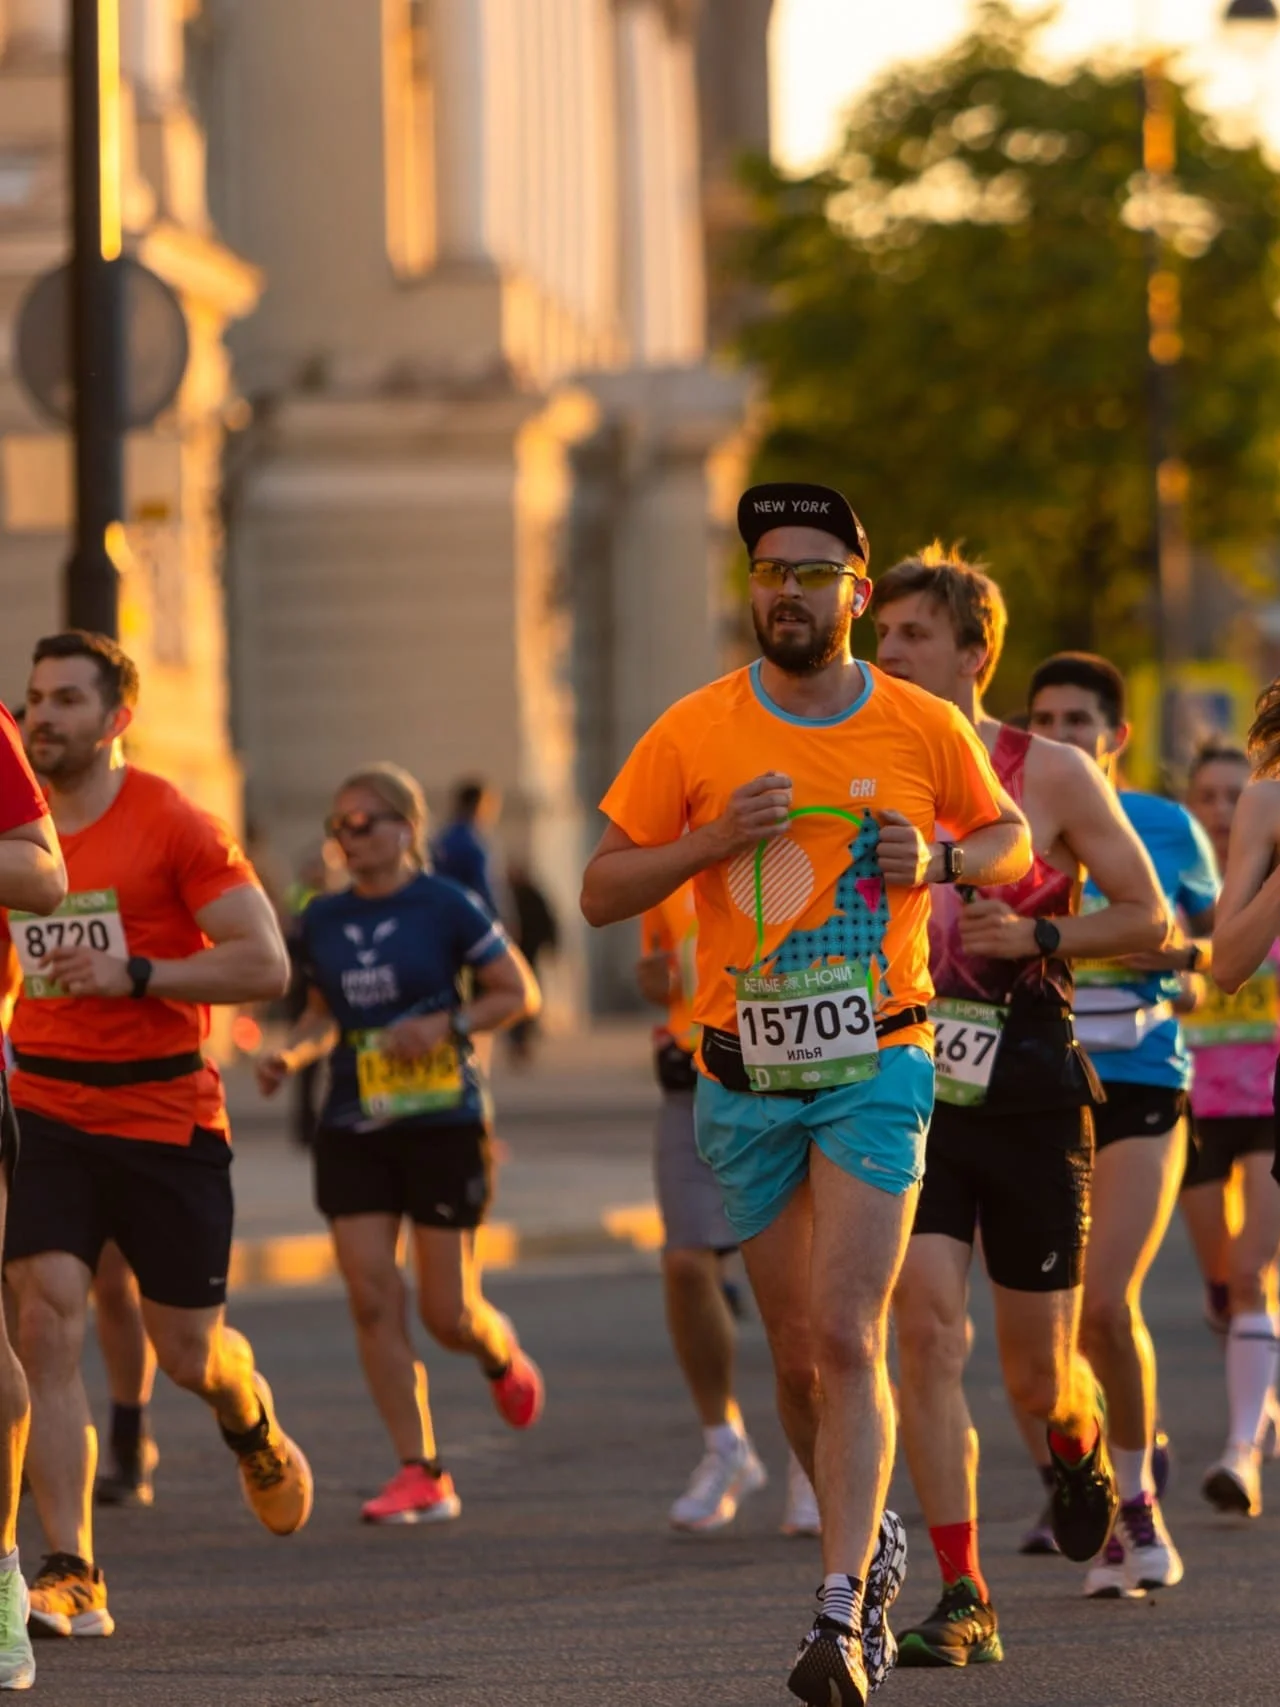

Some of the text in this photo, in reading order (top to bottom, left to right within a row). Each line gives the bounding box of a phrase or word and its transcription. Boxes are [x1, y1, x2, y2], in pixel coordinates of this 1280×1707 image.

[753, 500, 831, 514] NEW YORK
[26, 919, 109, 958] 8720
[744, 976, 781, 993] БЕЛЫЕ
[804, 965, 853, 988] НОЧИ
[742, 995, 870, 1046] 15703
[787, 1047, 823, 1061] ИЛЬЯ
[755, 1068, 771, 1089] D
